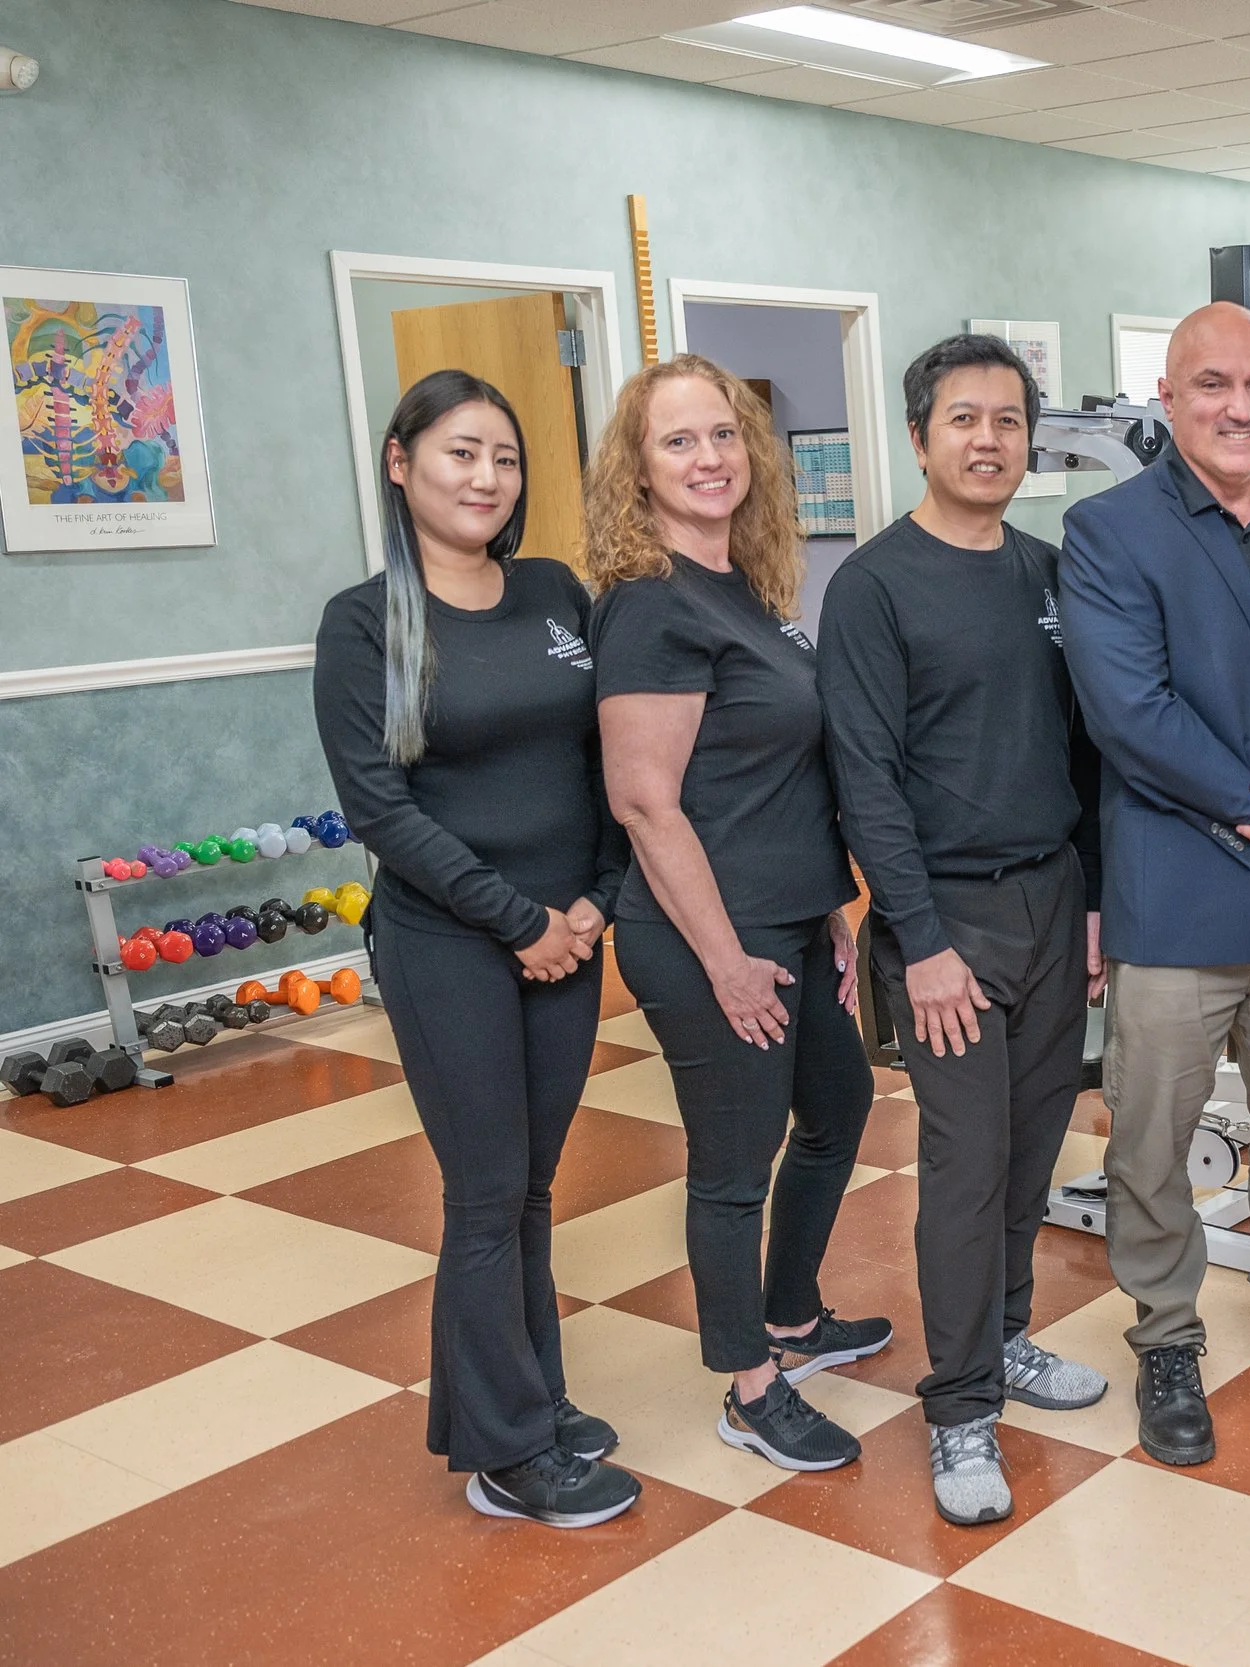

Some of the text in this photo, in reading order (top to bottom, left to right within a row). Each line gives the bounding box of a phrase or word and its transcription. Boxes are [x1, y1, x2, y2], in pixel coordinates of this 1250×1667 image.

[55, 512, 167, 523] THE FINE ART OF HEALING
[548, 637, 584, 655] ADVANC
